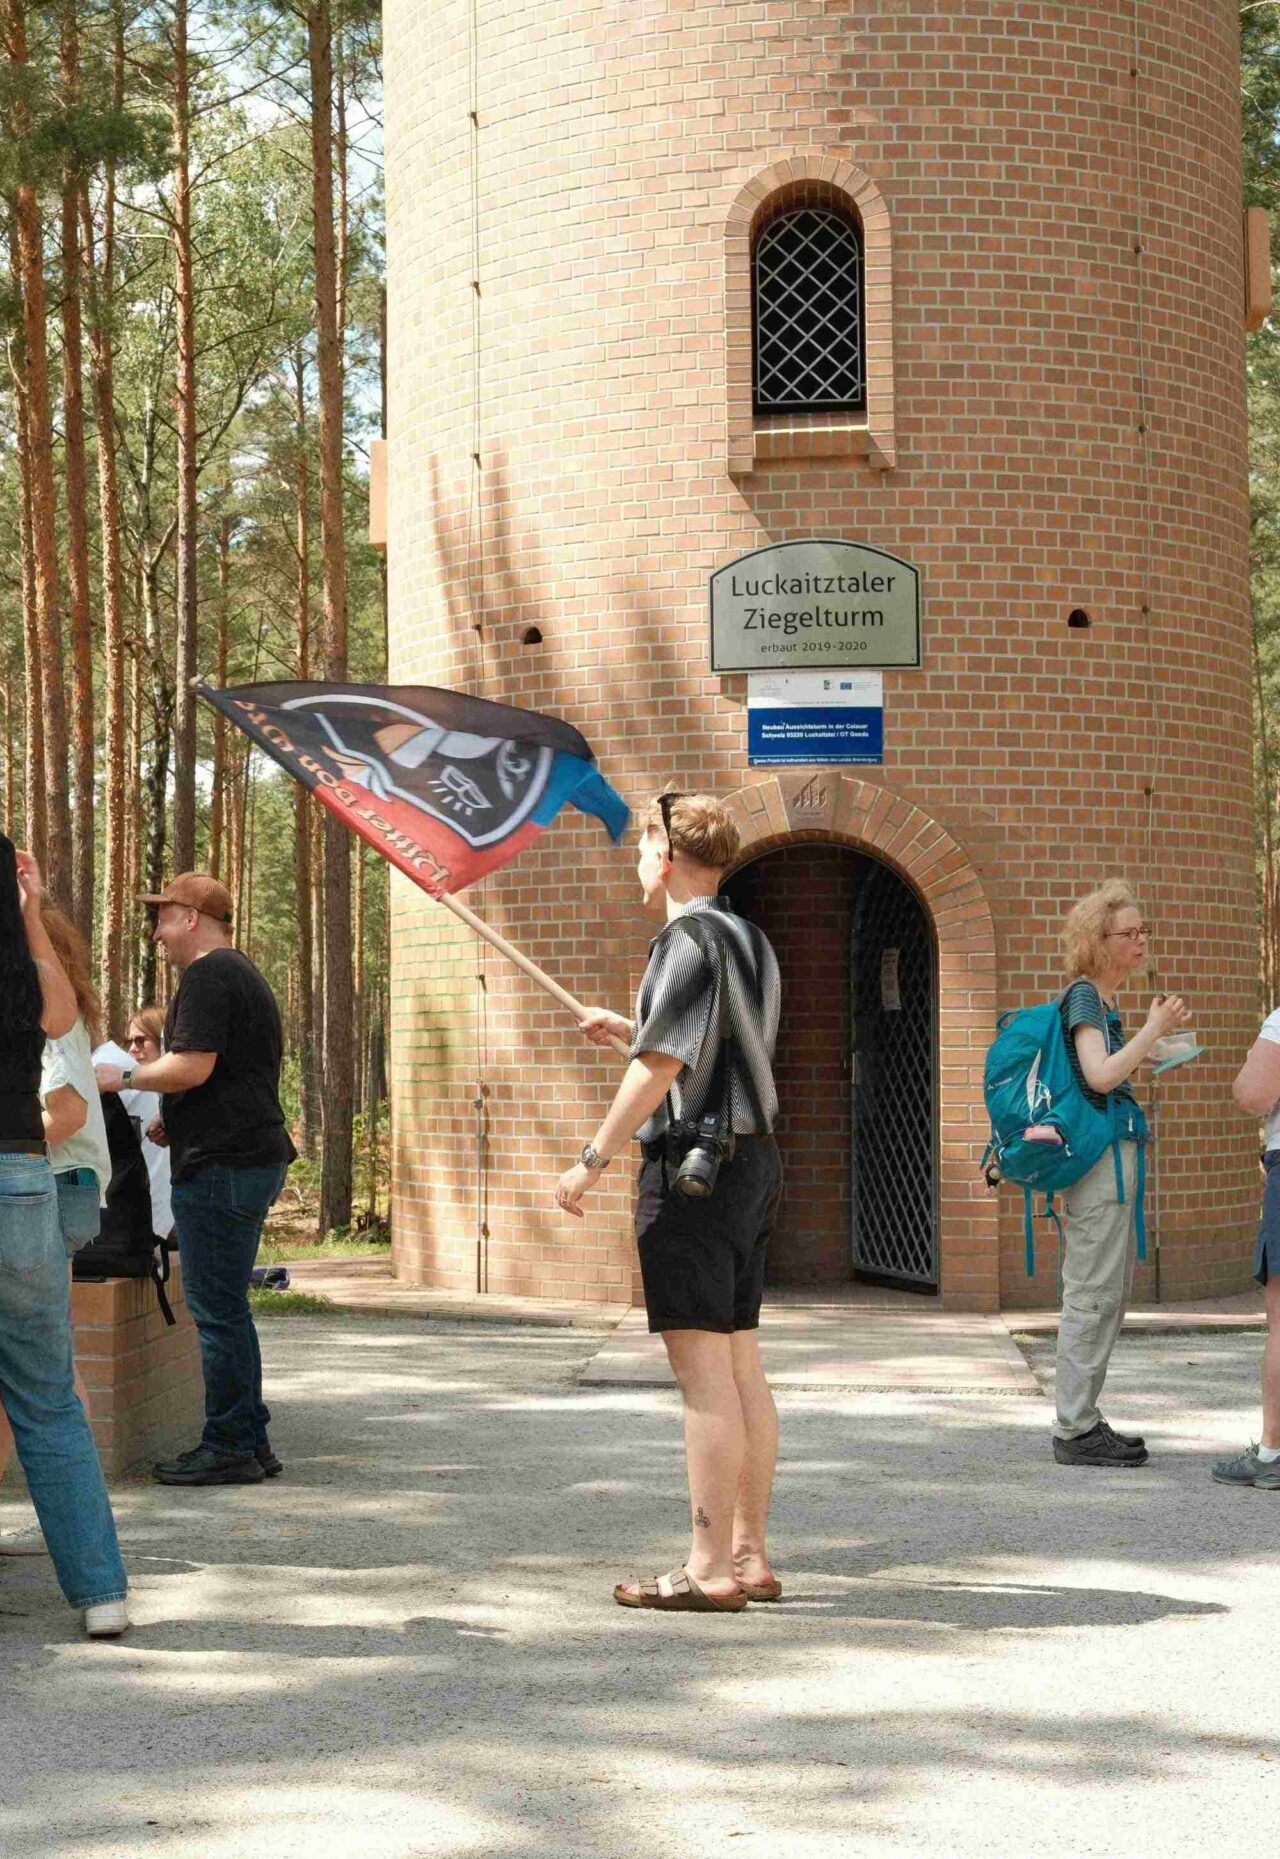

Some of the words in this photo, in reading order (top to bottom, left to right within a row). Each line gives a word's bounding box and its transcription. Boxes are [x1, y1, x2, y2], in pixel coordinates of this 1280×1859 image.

[732, 571, 896, 596] Luckaitztaler
[743, 605, 884, 635] Ziegelturm
[761, 643, 797, 653] erbaut
